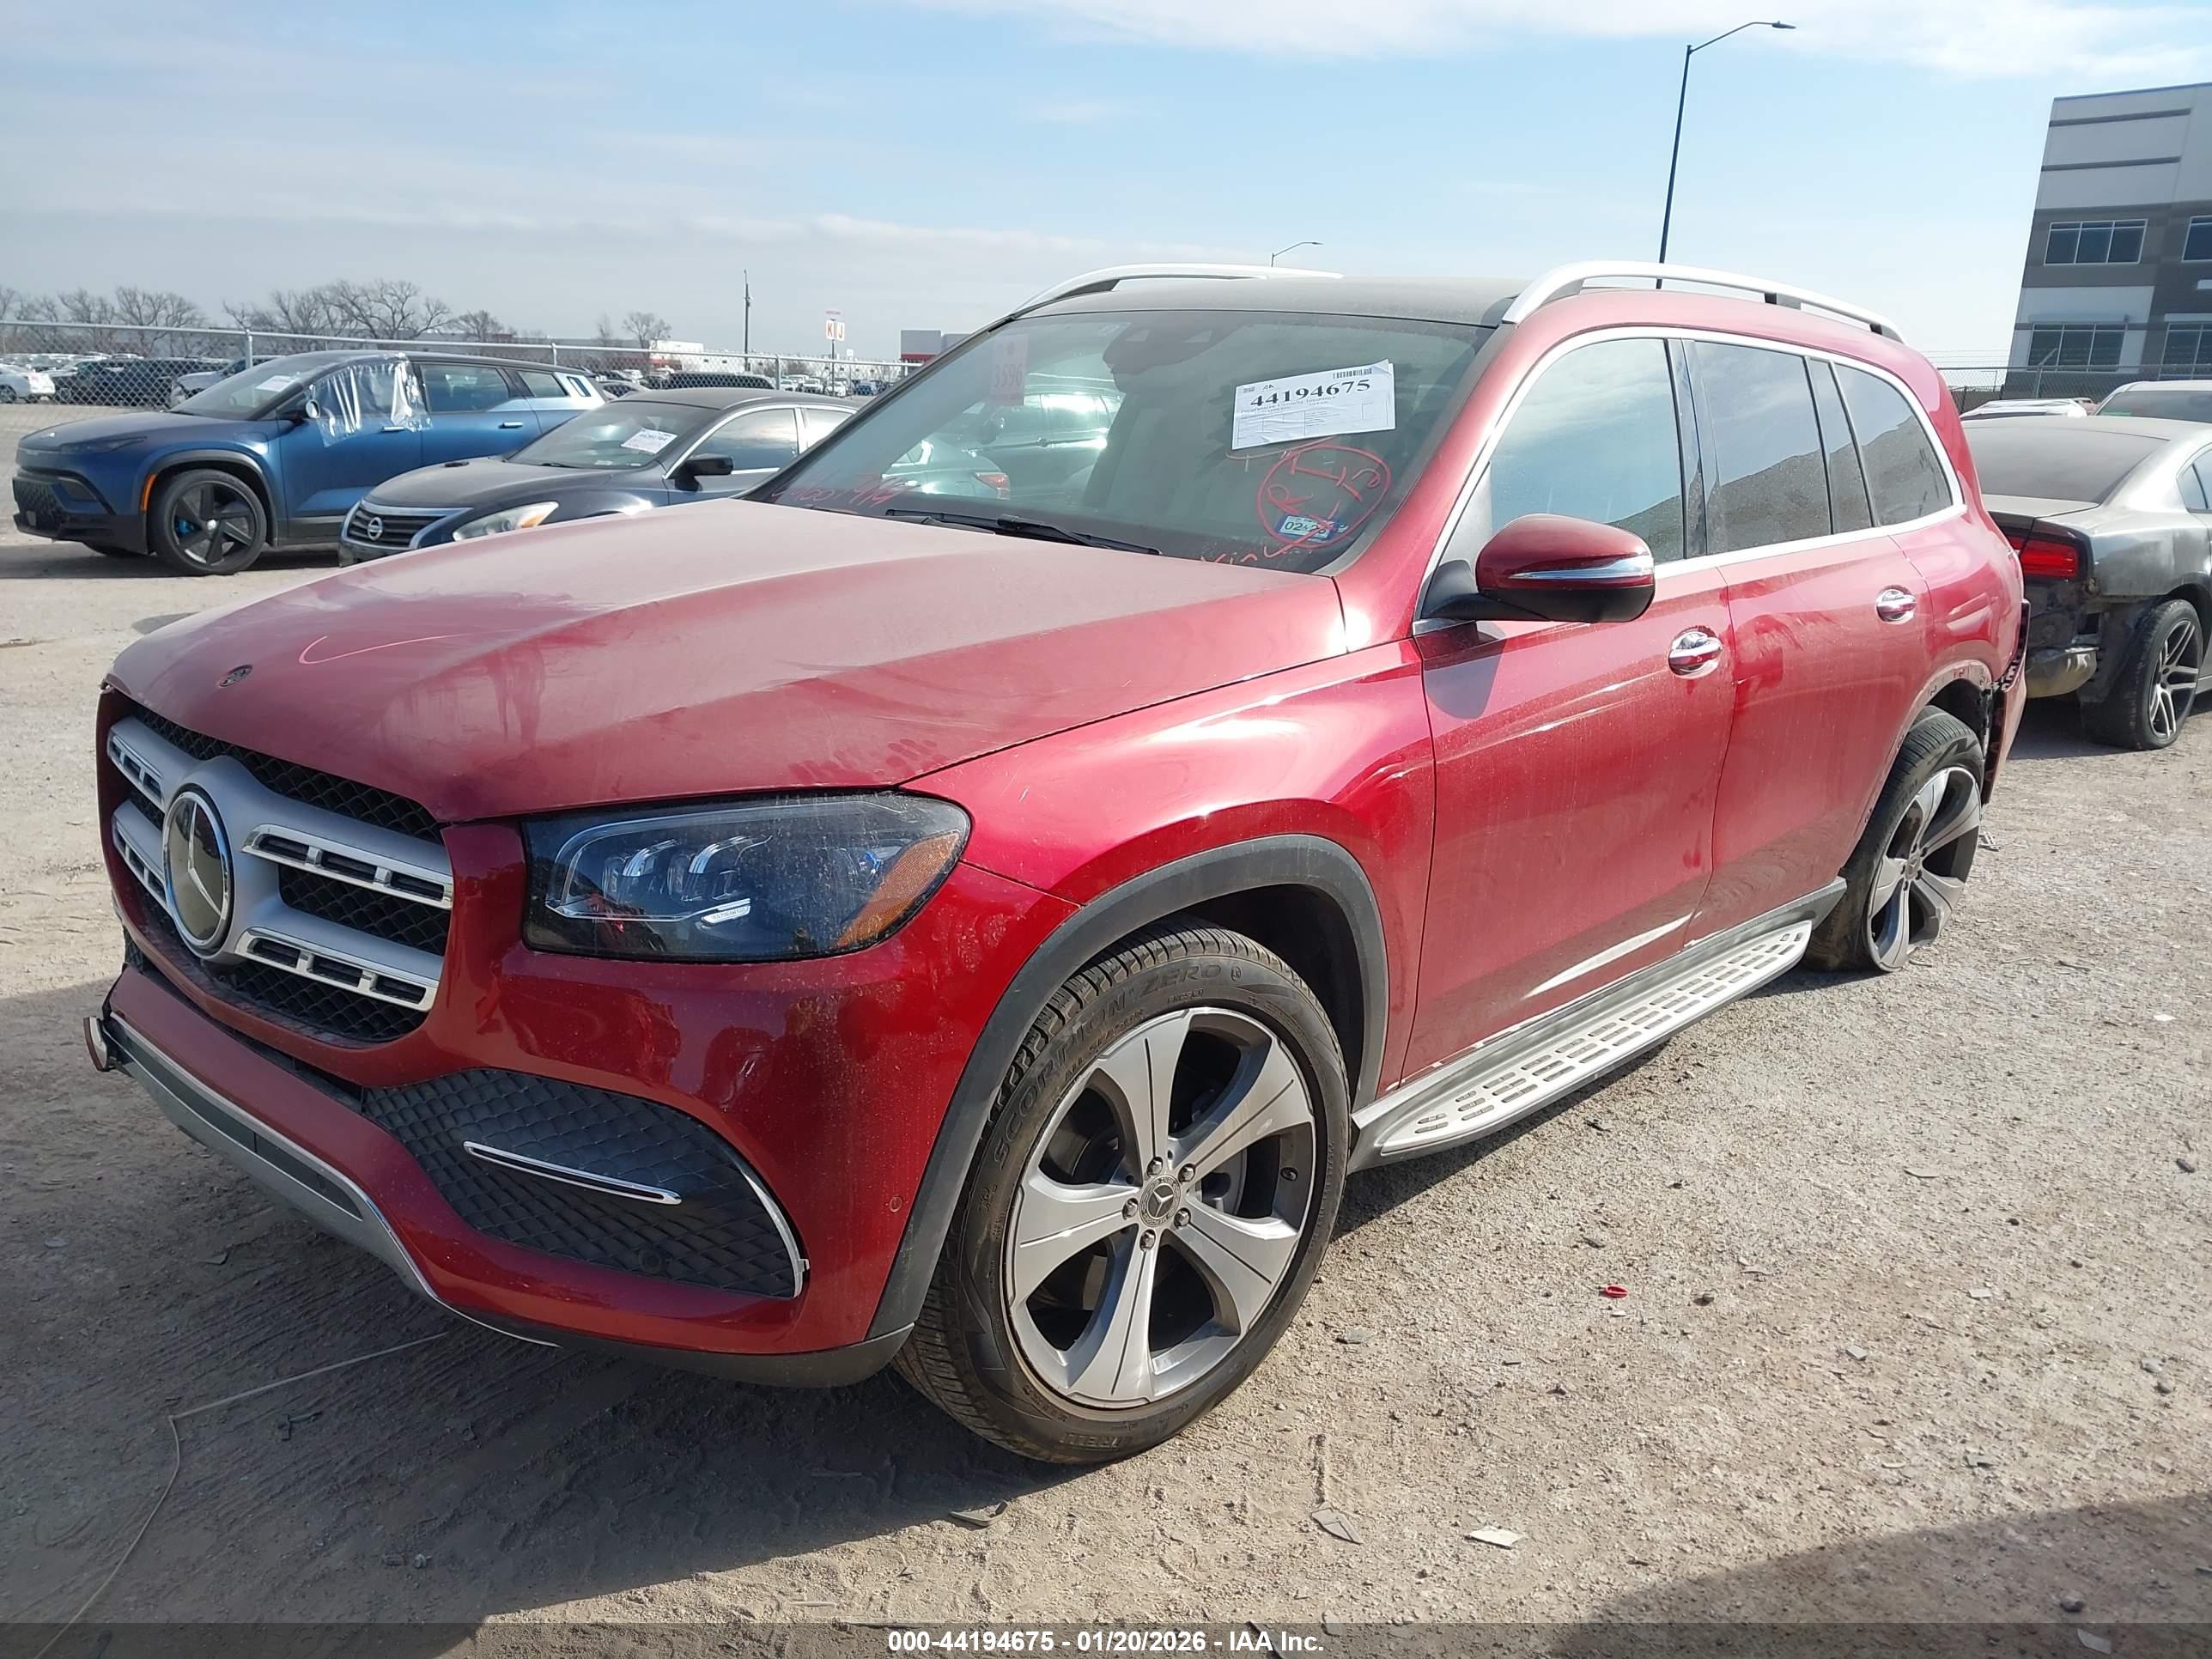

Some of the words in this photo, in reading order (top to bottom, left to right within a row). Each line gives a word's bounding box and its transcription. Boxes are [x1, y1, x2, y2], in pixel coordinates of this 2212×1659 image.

[1249, 379, 1371, 407] 44194675
[1284, 521, 1304, 531] 02
[994, 991, 1126, 1171] SCORPION
[1139, 964, 1222, 997] ZERO
